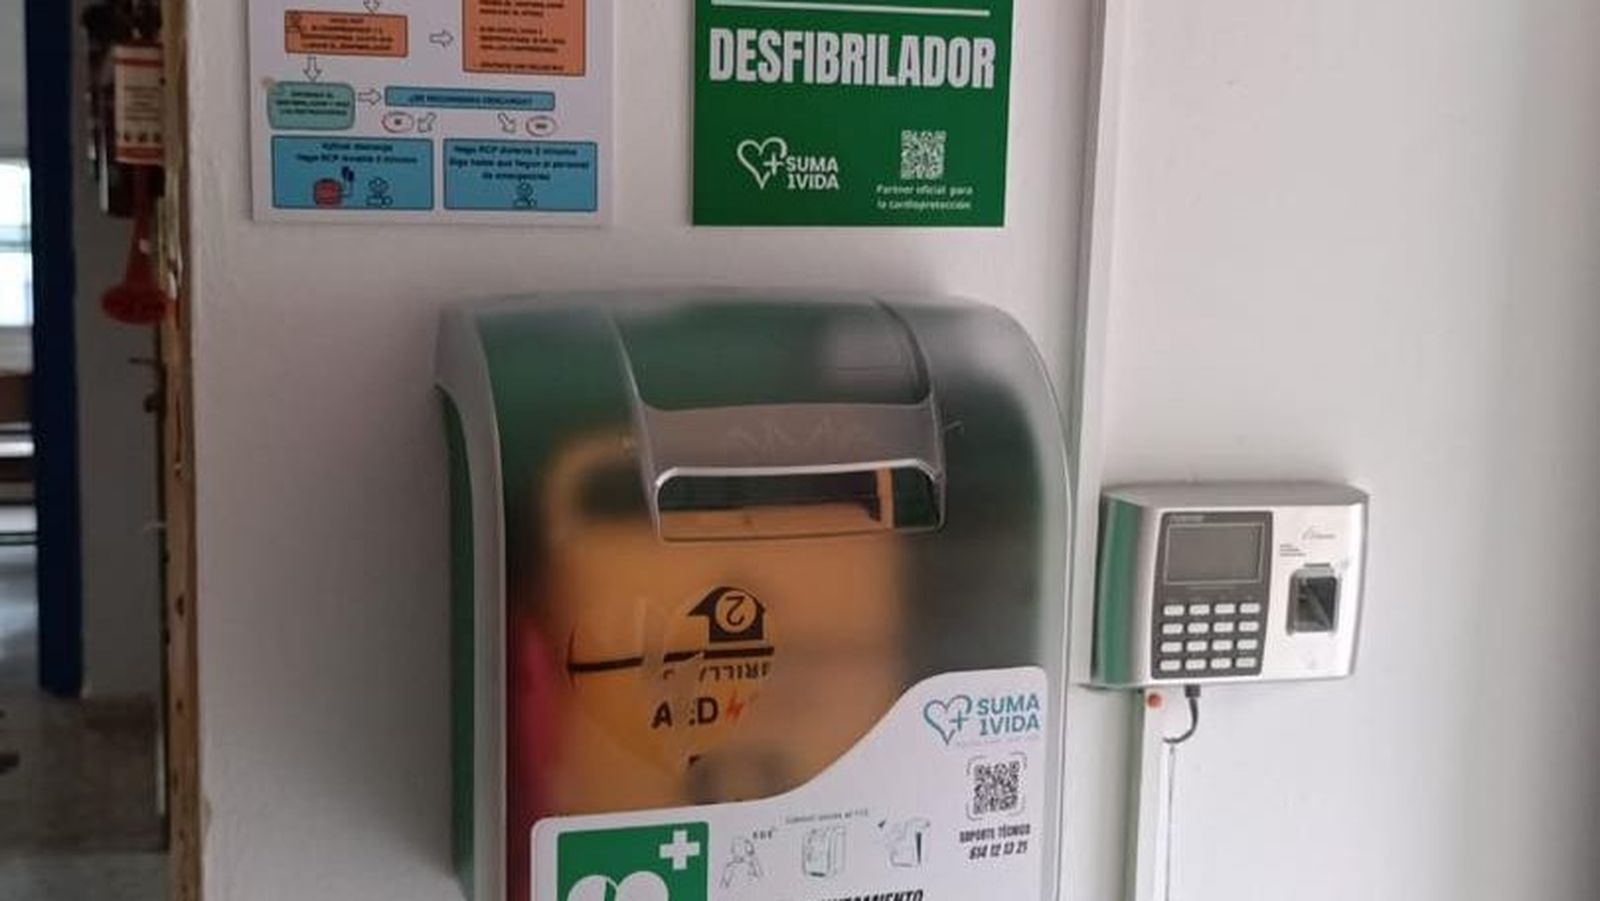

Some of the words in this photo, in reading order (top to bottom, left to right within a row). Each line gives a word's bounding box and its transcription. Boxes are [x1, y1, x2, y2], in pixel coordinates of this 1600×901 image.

[709, 27, 996, 89] DESFIBRILADOR
[786, 155, 839, 172] SUMA
[876, 184, 914, 195] Partner
[915, 184, 946, 195] oficial
[949, 185, 973, 198] para
[877, 200, 887, 210] la
[724, 595, 746, 626] 2
[977, 692, 1040, 716] SUMA
[959, 827, 996, 843] SOPORTE
